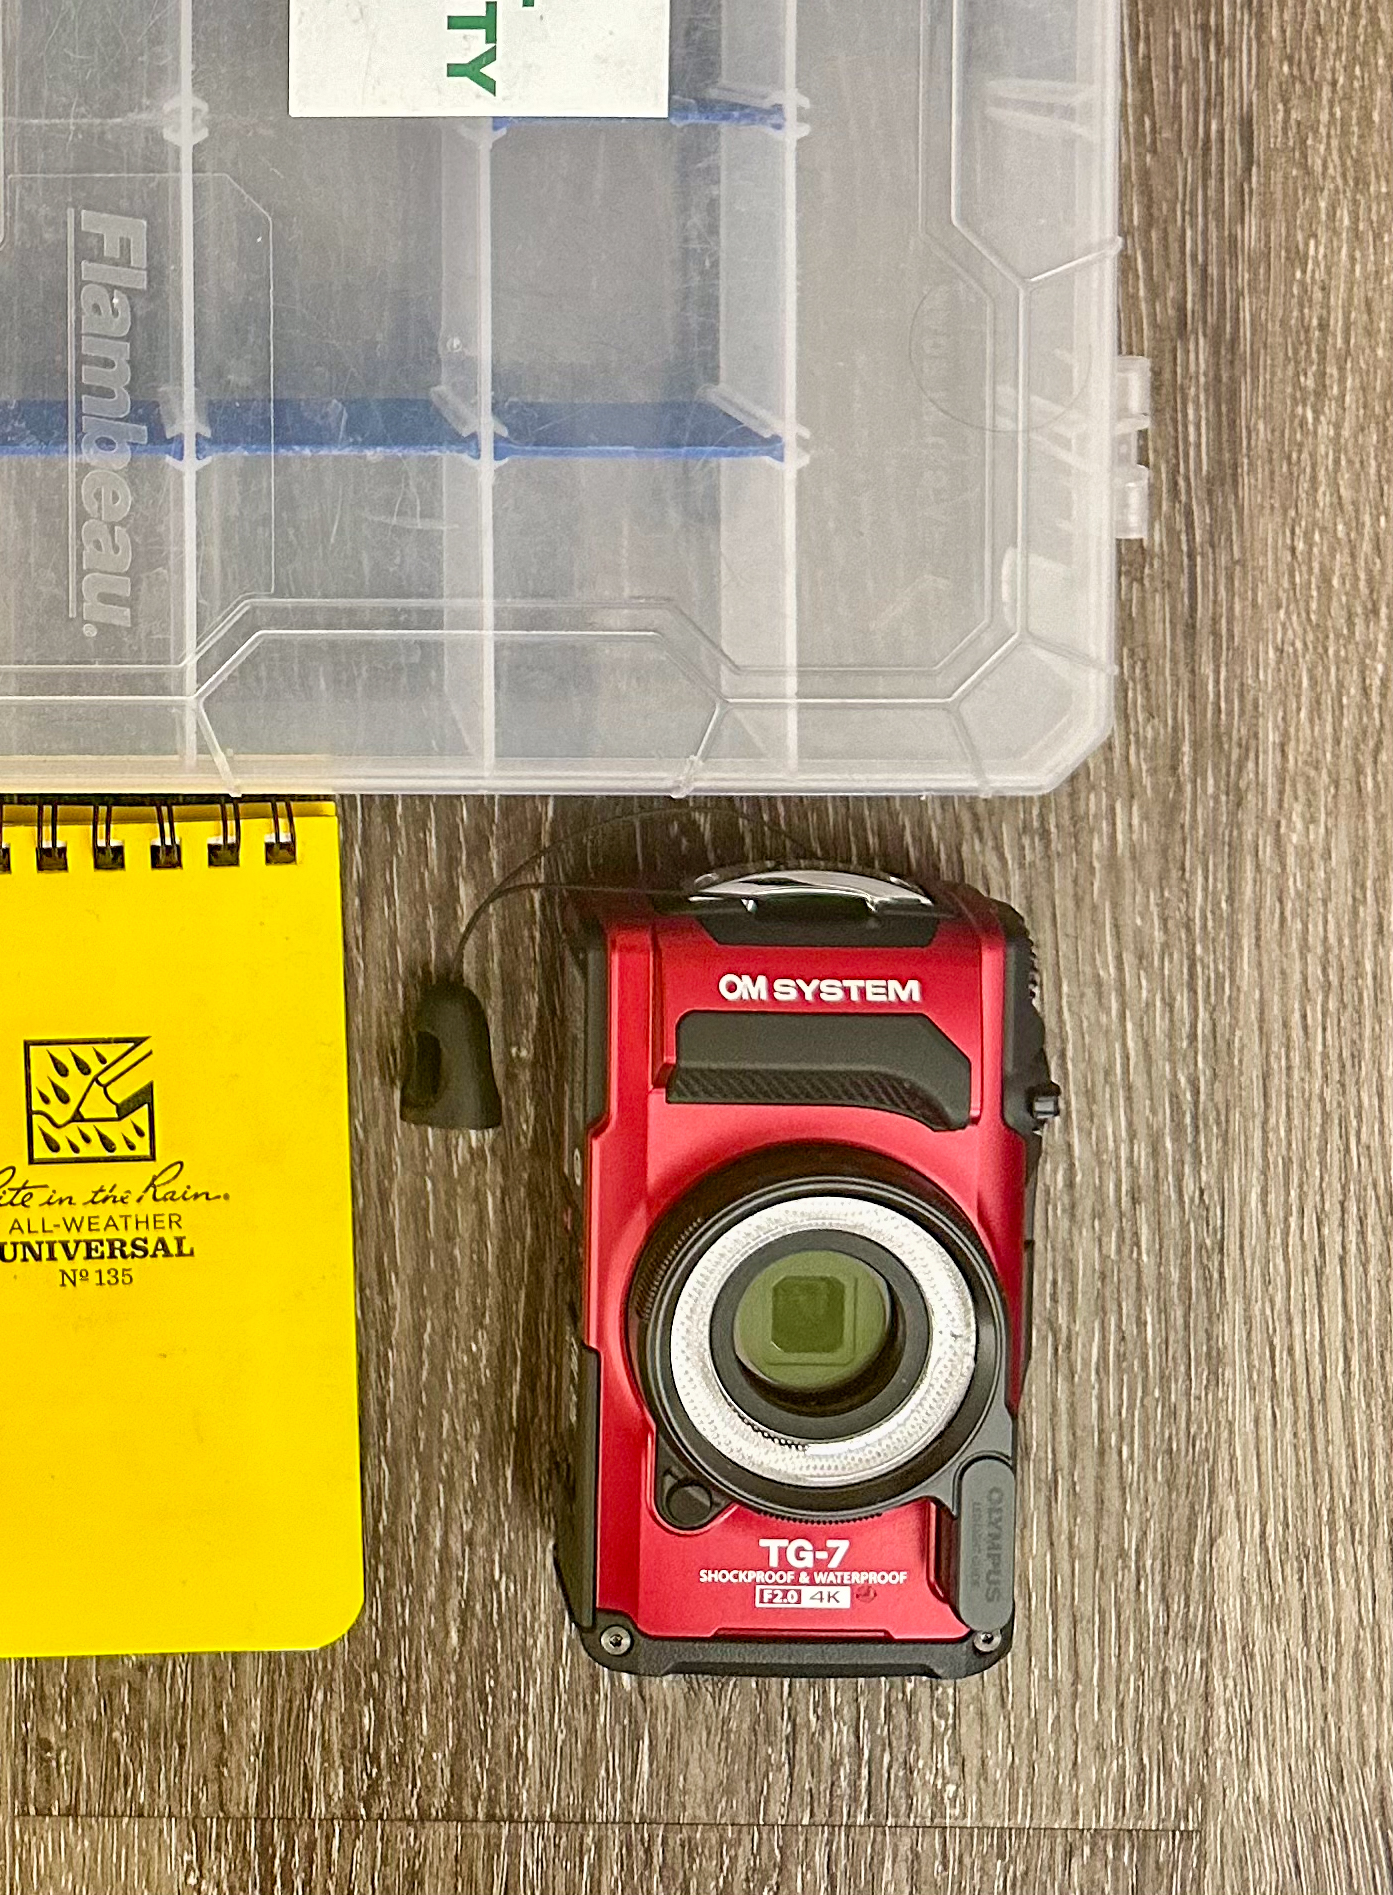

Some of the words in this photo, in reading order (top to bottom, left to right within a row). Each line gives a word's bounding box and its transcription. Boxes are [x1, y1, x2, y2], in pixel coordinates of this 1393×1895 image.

[718, 973, 768, 1000] OM
[773, 978, 922, 1002] SYSTEM
[38, 1189, 77, 1207] in
[81, 1183, 133, 1206] the
[8, 1212, 183, 1236] ALL-WEATHER
[95, 1267, 134, 1287] 135
[758, 1538, 851, 1569] TG-7
[699, 1570, 795, 1584] SHOCKPROOF
[799, 1571, 810, 1584] &
[813, 1571, 908, 1585] WATERPROOF
[762, 1589, 798, 1604] F2.0
[809, 1590, 841, 1604] 4K
